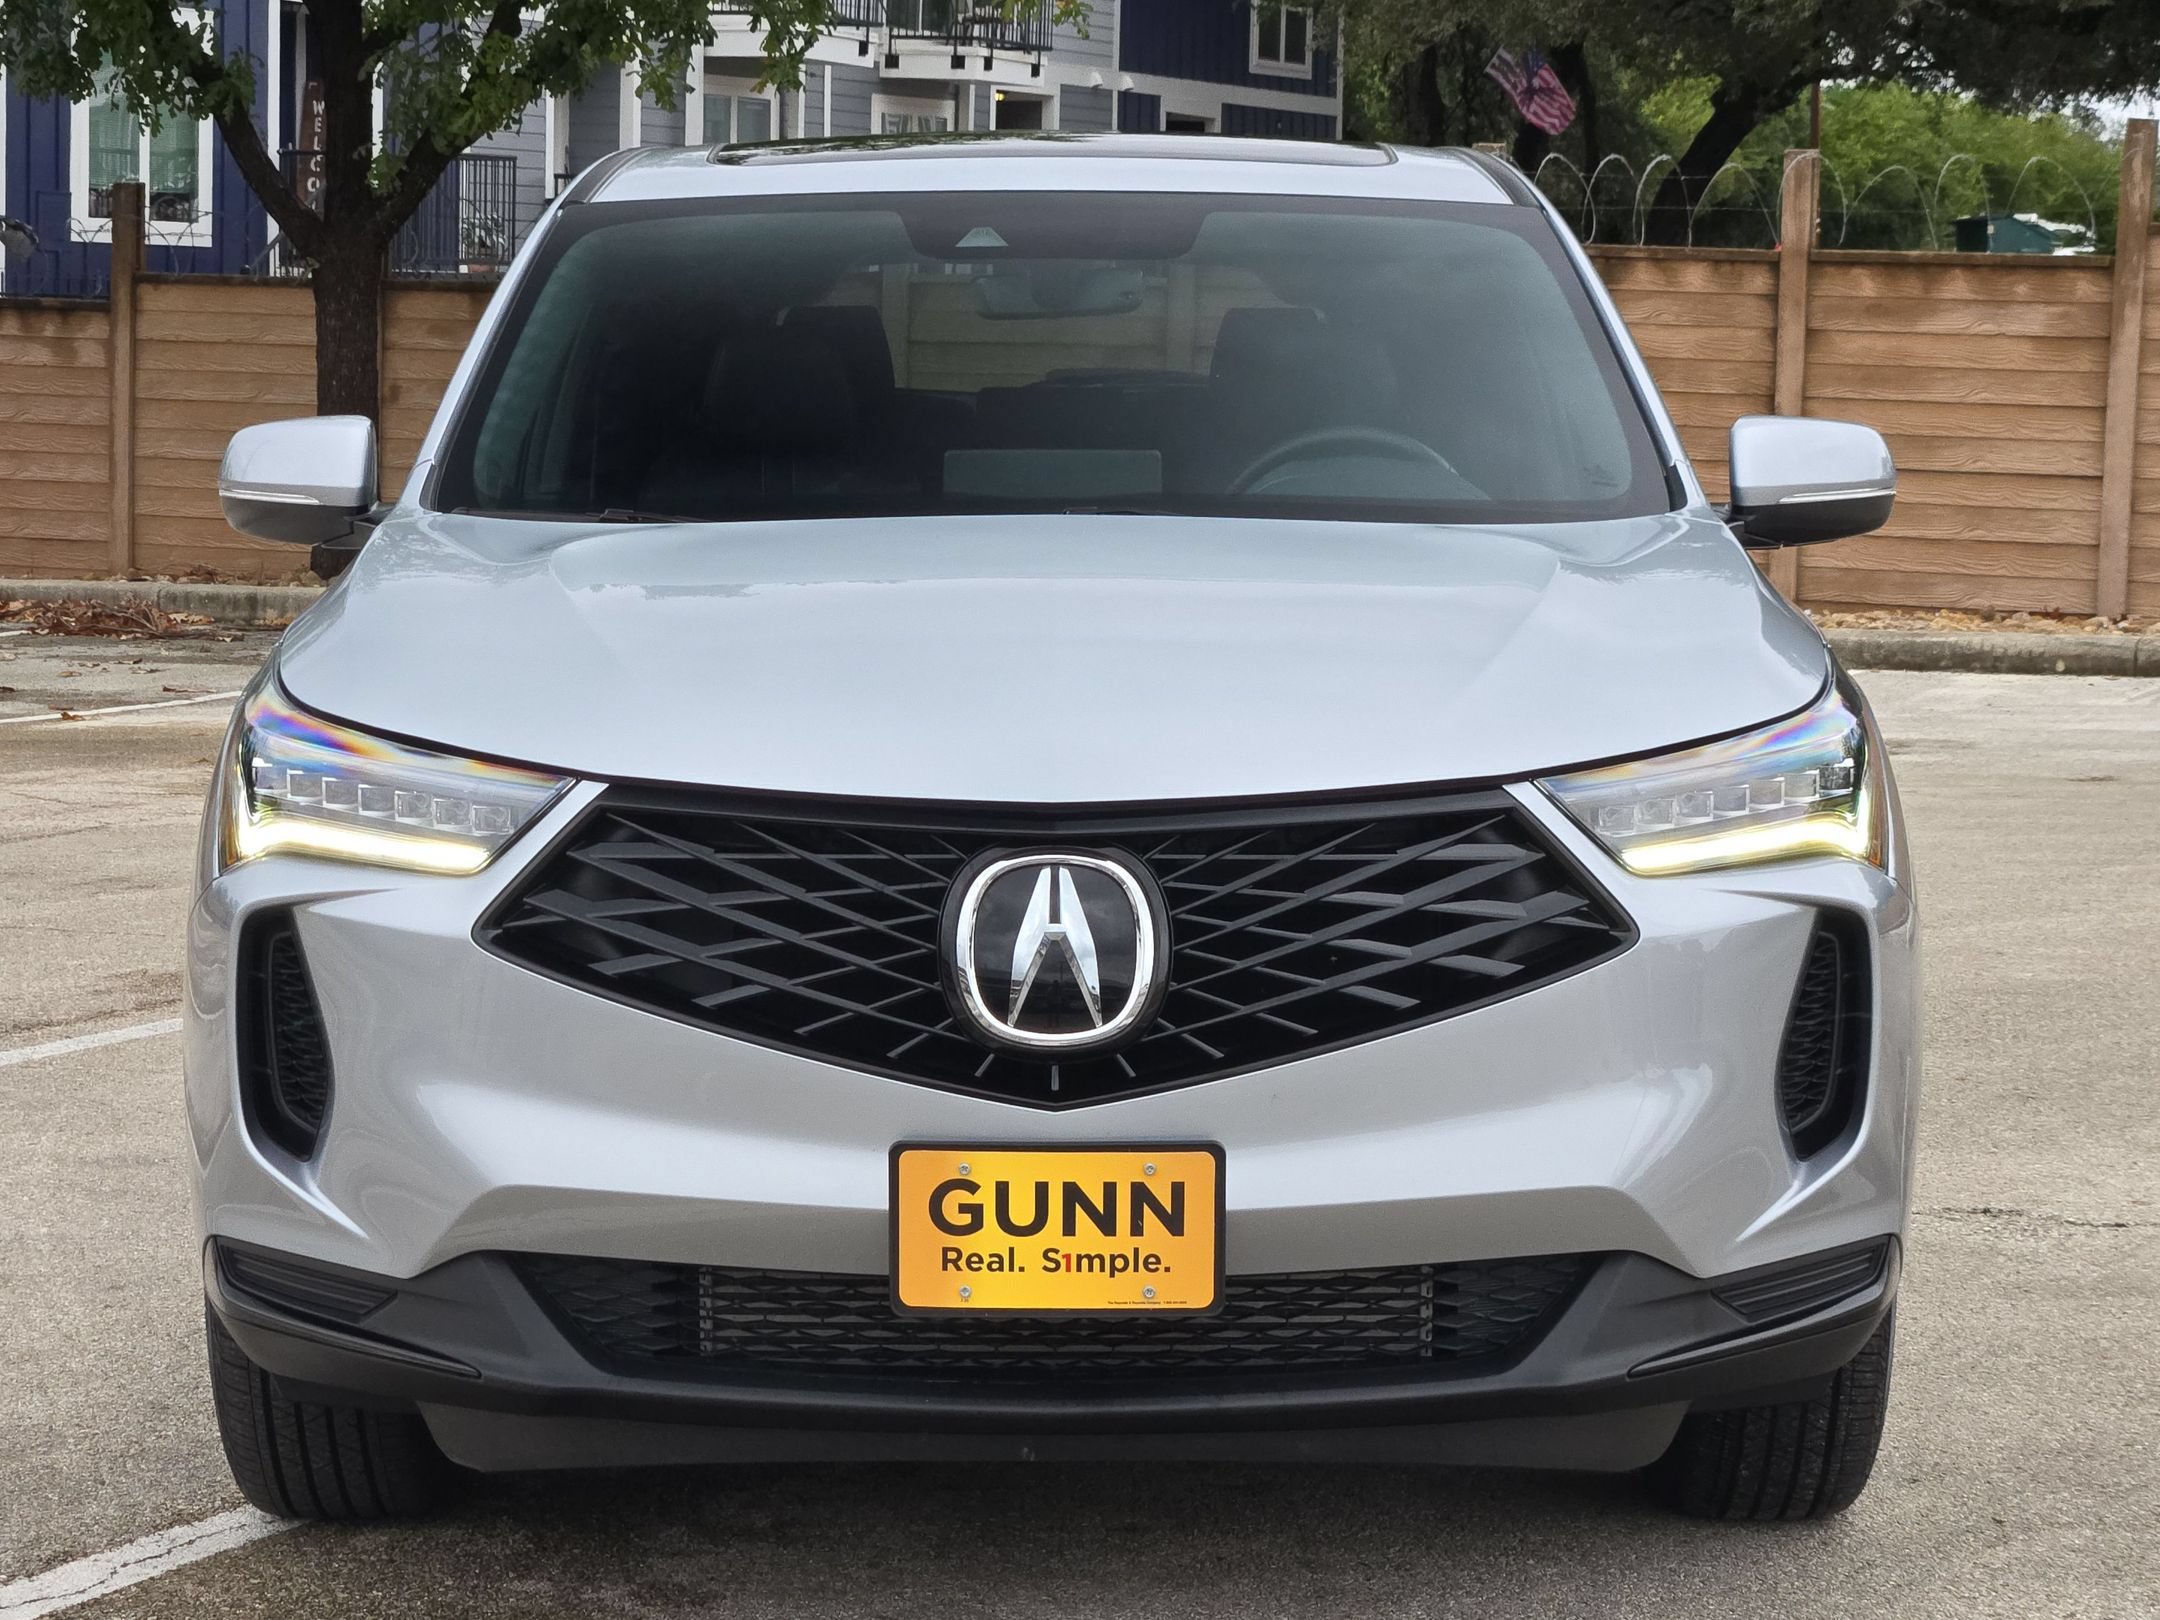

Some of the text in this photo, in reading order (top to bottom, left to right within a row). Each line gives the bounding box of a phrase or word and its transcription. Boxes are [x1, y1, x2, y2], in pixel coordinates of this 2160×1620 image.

[306, 99, 326, 211] WELCO
[928, 1178, 1185, 1238] GUNN
[941, 1246, 1171, 1278] Real. S1mple.
